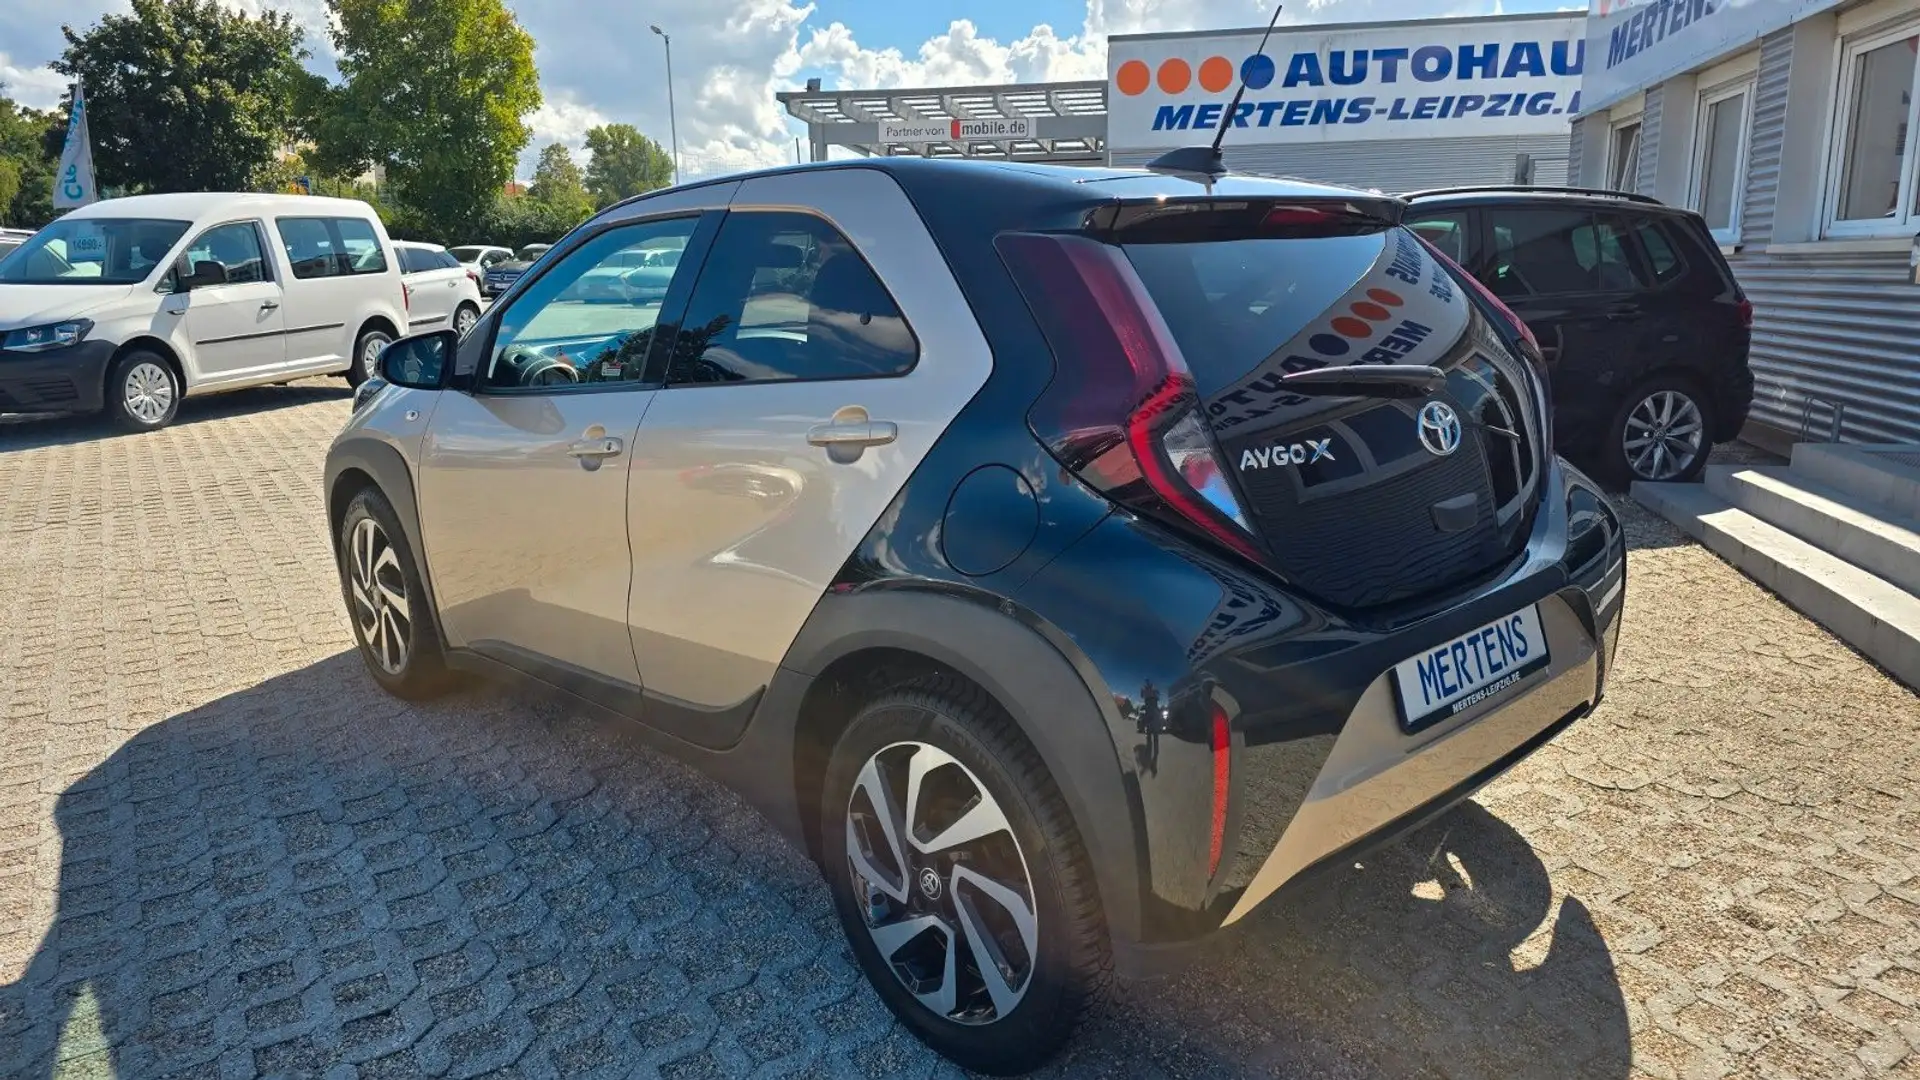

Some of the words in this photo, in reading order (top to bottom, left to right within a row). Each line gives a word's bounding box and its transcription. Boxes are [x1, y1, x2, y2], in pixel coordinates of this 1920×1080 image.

[1606, 0, 1714, 70] MERTEN
[886, 126, 924, 137] Partner
[926, 127, 945, 136] von
[961, 120, 1025, 136] mobile.de
[1416, 614, 1529, 706] MERTENS
[1452, 671, 1521, 714] MERTENS-LEIPZIG.DE
